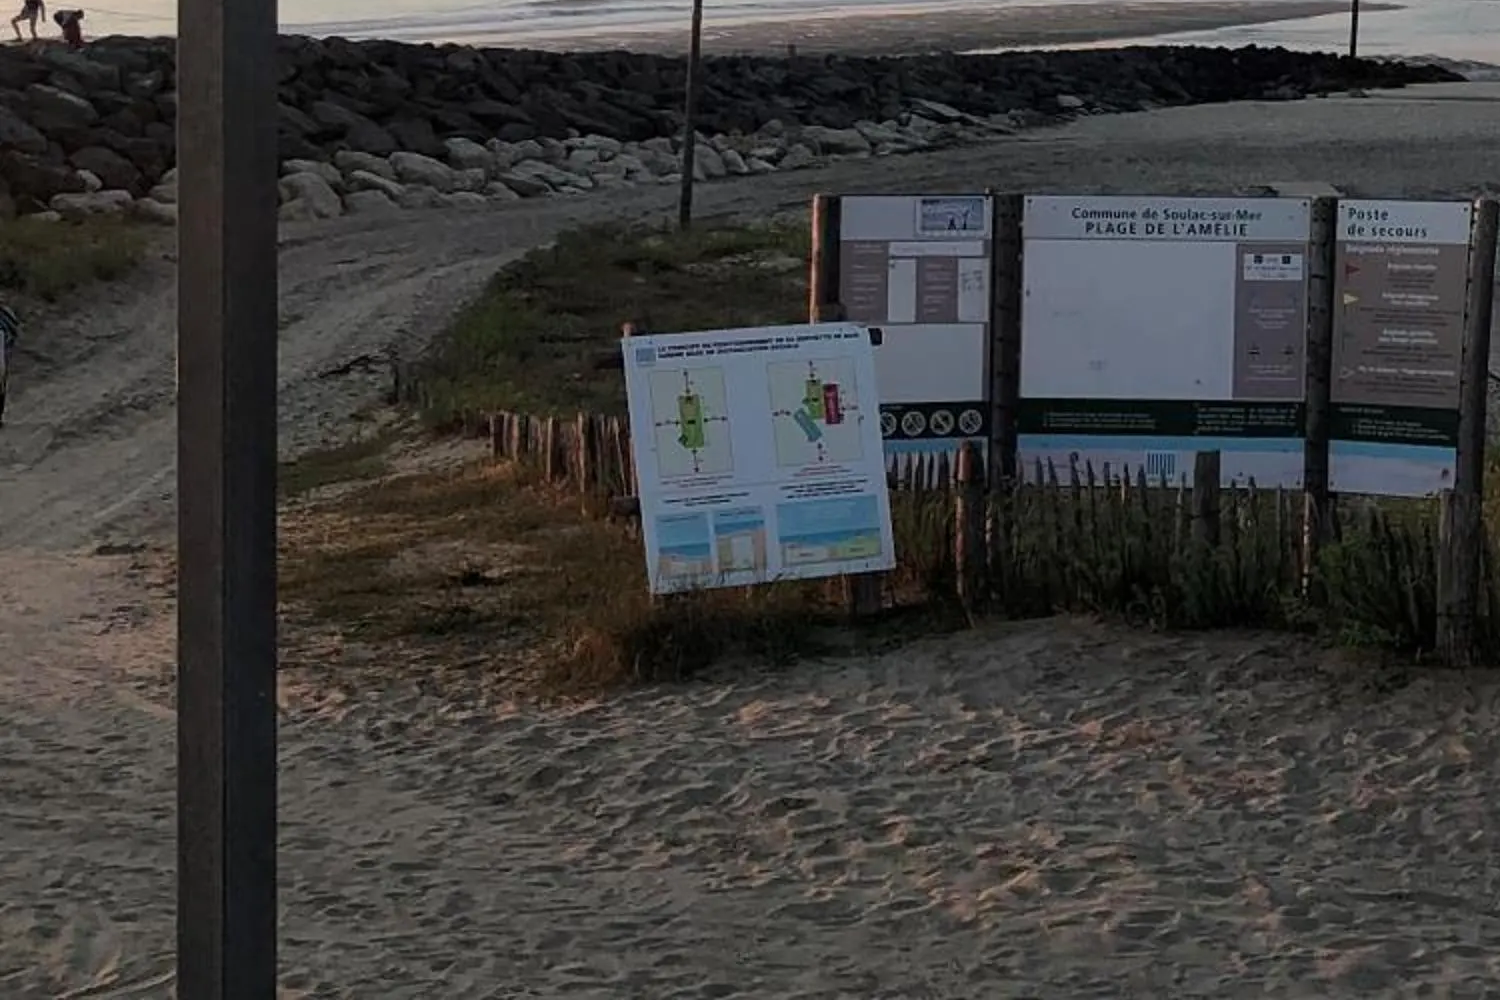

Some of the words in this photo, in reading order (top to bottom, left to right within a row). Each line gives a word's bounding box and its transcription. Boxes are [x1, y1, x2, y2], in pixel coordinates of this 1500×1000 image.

[1071, 207, 1137, 219] Commune
[1141, 207, 1160, 219] de
[1348, 207, 1389, 221] Poste
[1085, 221, 1137, 235] PLAGE
[1145, 222, 1165, 236] DE
[1347, 223, 1365, 236] de
[1371, 226, 1428, 238] secours
